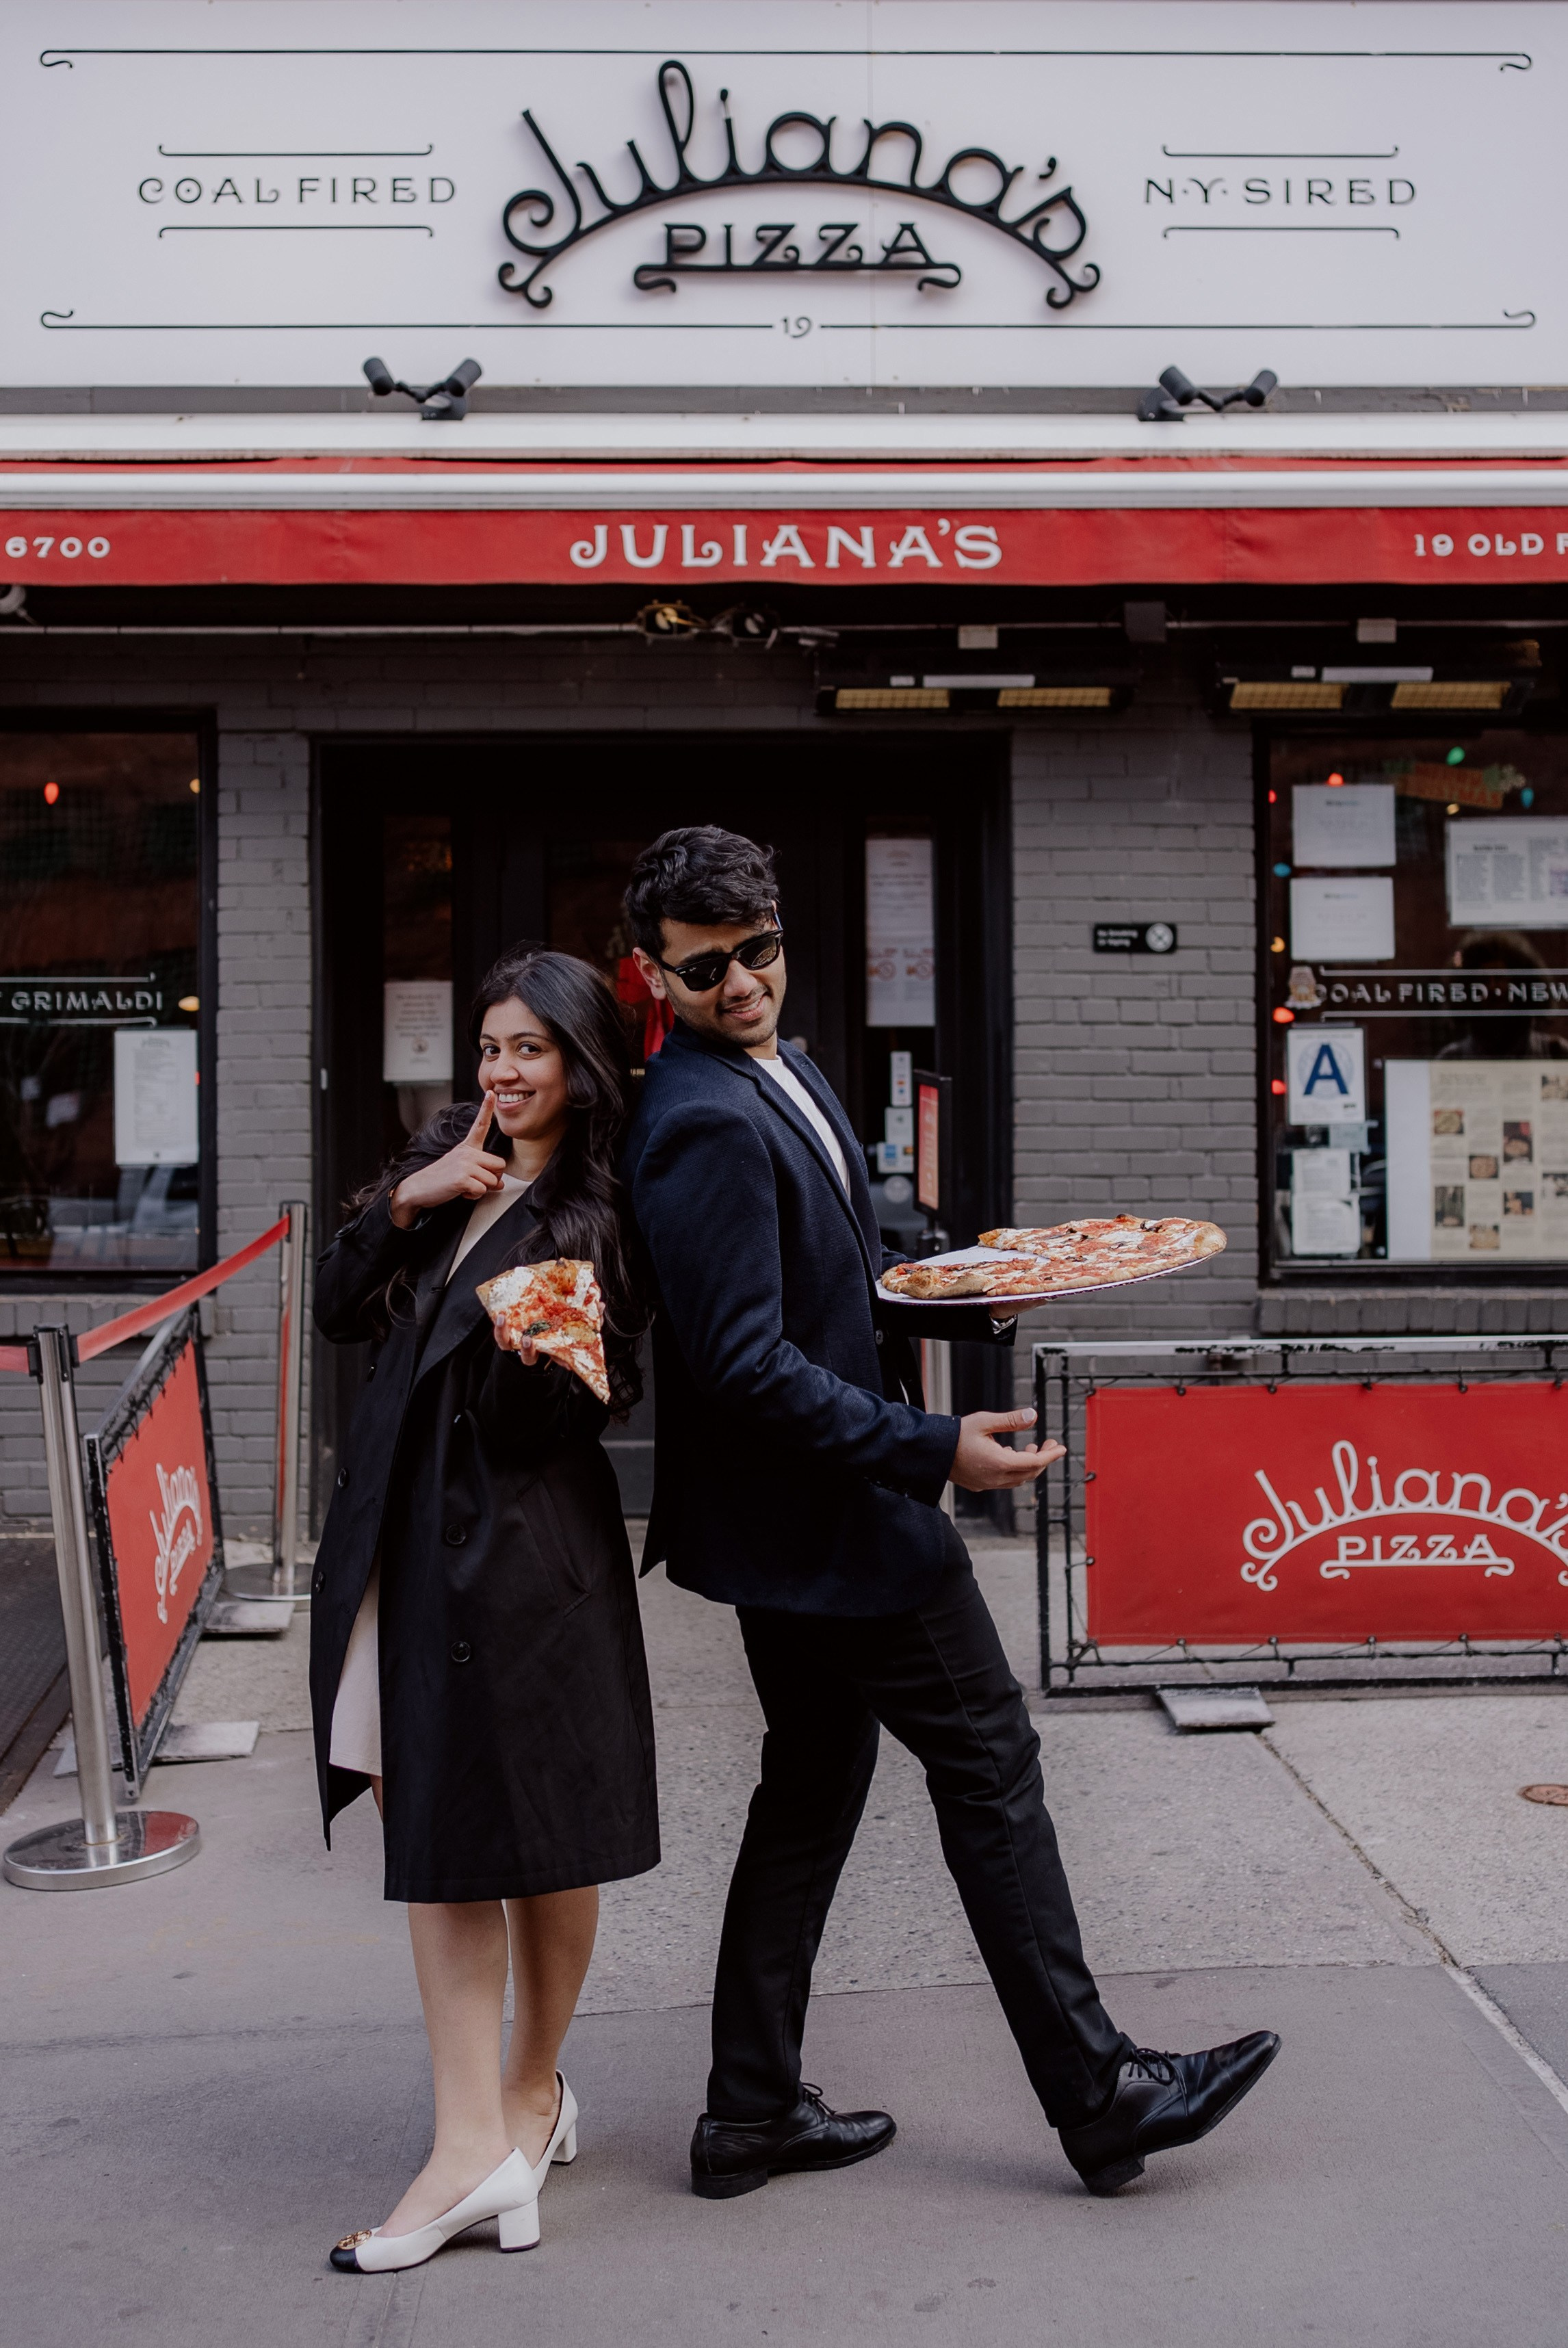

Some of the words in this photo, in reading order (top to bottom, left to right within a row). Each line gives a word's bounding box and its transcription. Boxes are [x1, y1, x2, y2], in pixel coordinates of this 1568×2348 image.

[502, 60, 1087, 261] Juliana's
[137, 177, 280, 204] COAL
[298, 177, 455, 204] FIRED
[1244, 177, 1416, 205] SIRED
[664, 223, 936, 265] PIZZA
[781, 316, 812, 339] 19
[5, 536, 111, 559] 6700
[569, 518, 1002, 569] JULIANA'S
[1413, 534, 1454, 556] 19
[1467, 533, 1545, 556] OLD
[11, 991, 163, 1011] GRIMALDI
[1398, 982, 1489, 1003] FIRED
[1303, 1043, 1350, 1095] A
[1337, 1534, 1500, 1562] PIZZA
